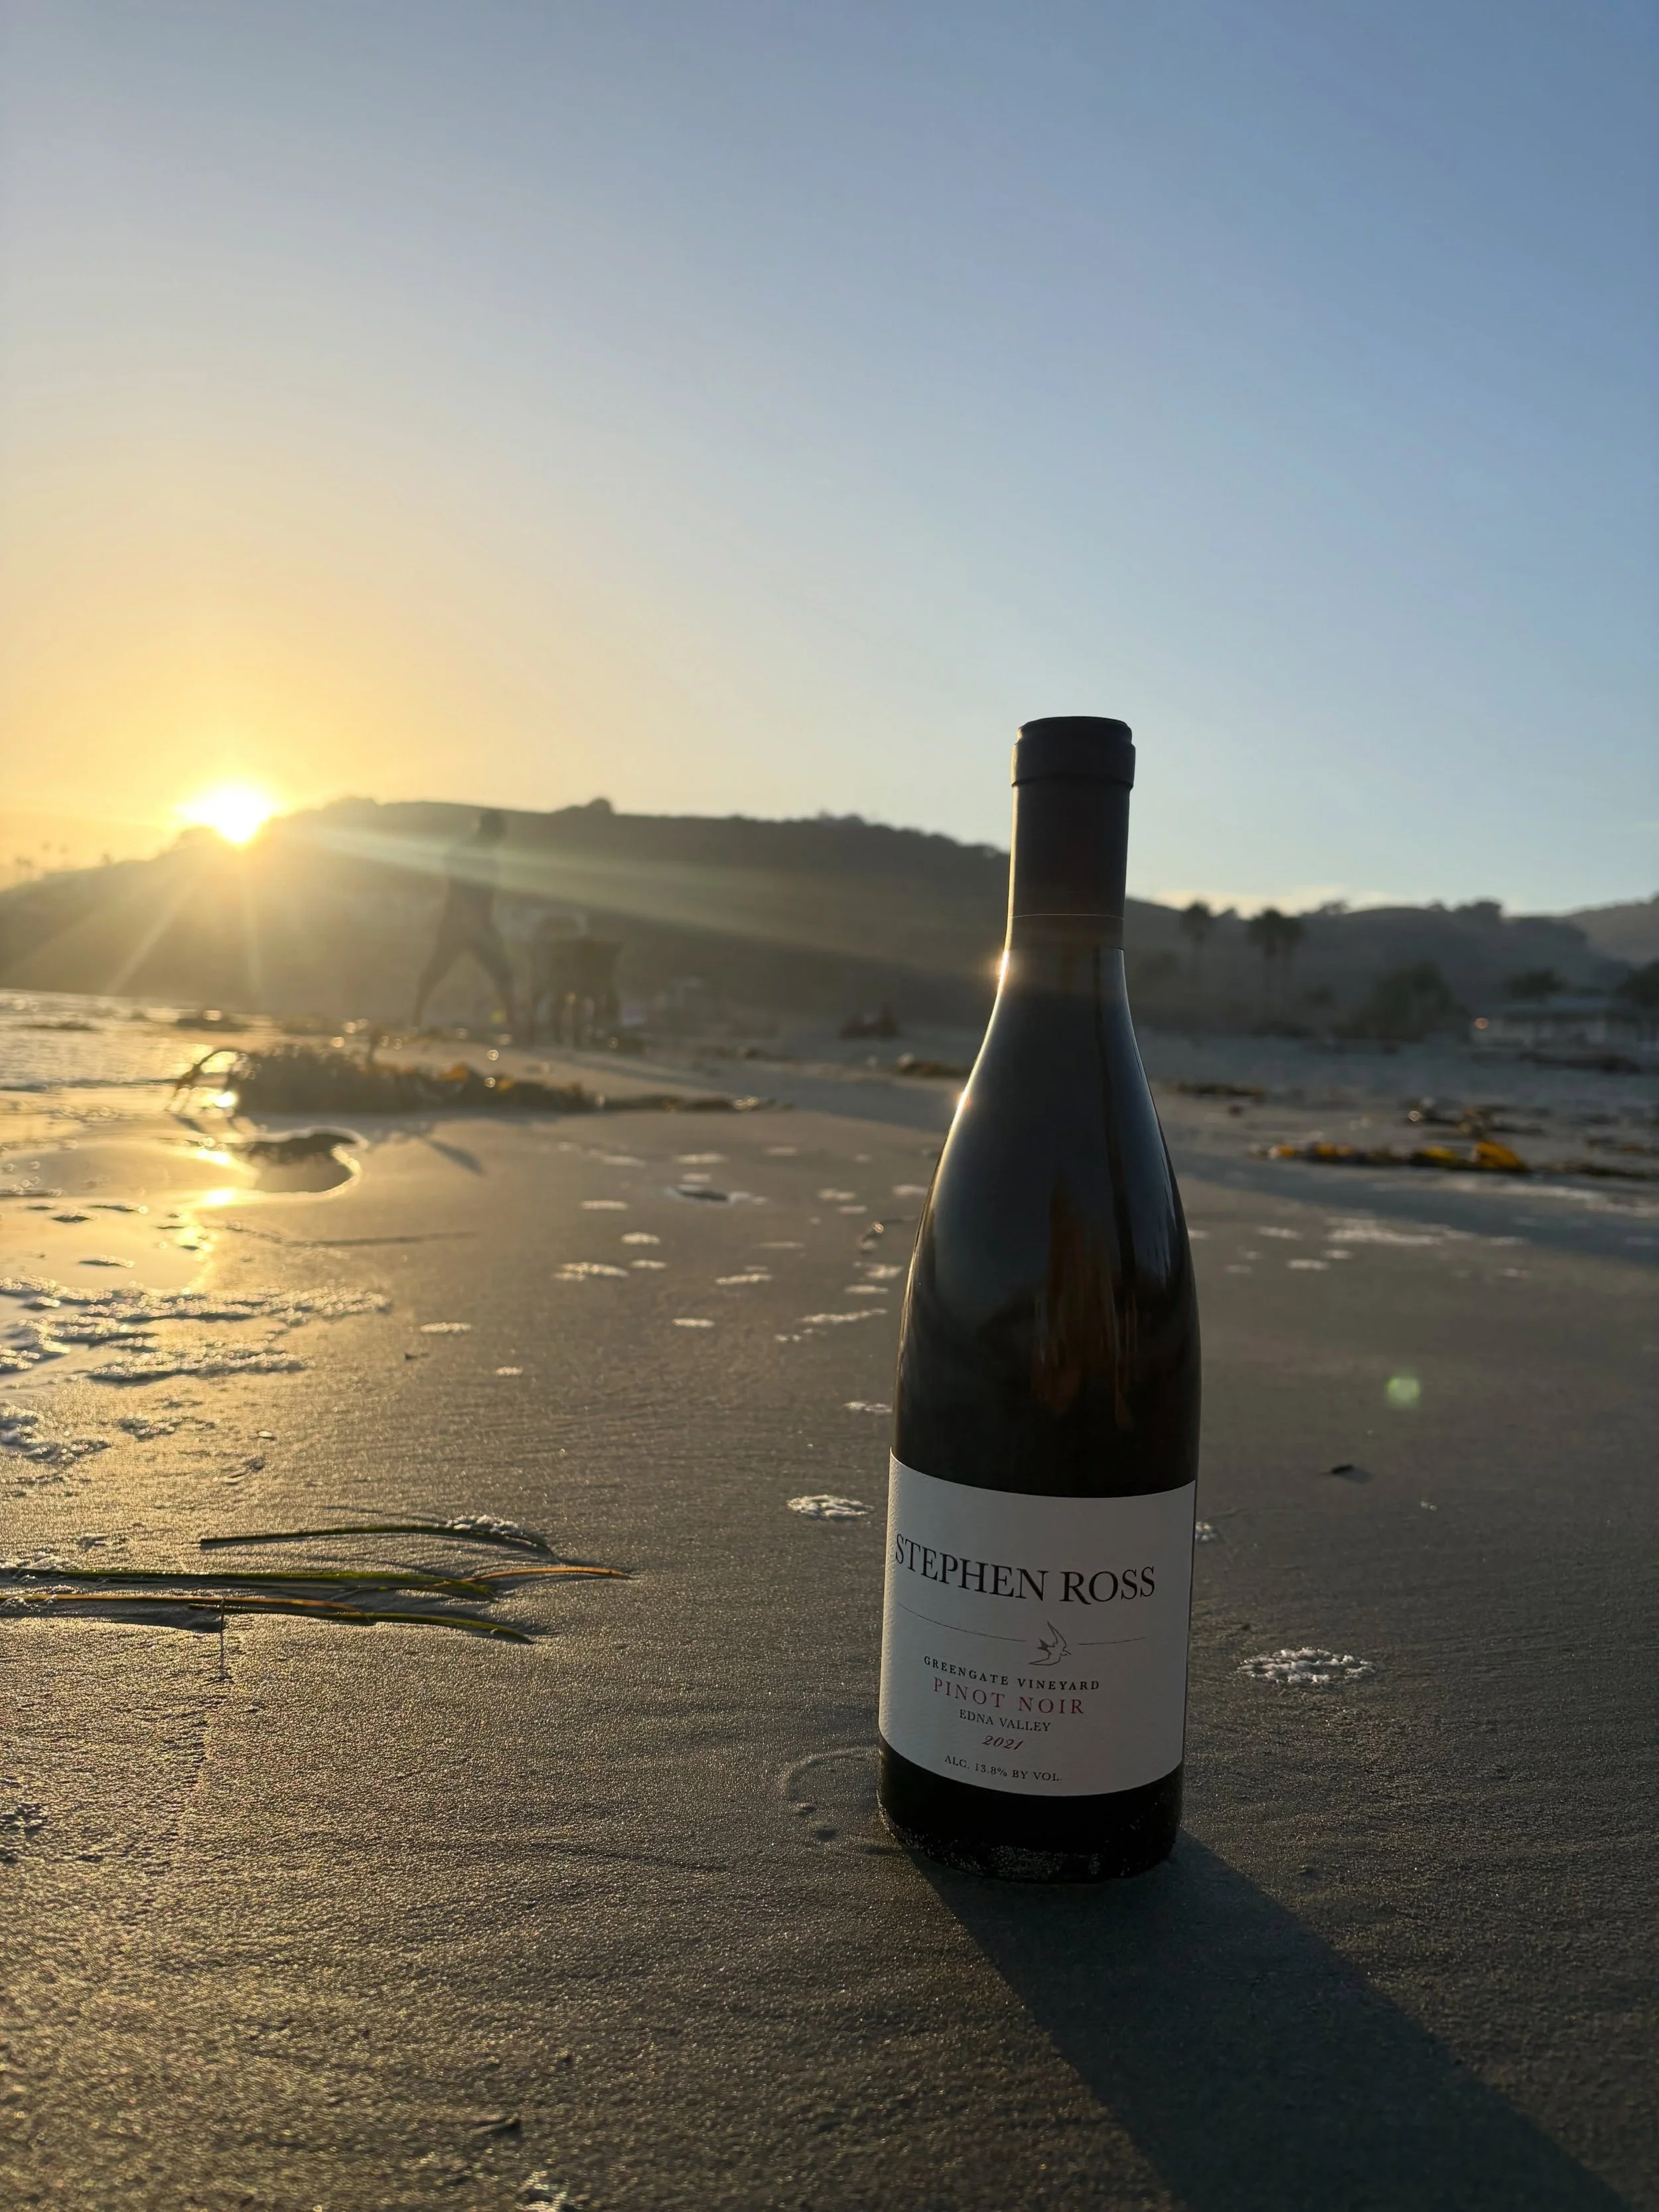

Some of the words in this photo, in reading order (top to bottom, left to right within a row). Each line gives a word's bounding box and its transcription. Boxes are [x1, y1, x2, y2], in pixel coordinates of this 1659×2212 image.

[895, 1533, 1049, 1601] STEPHEN
[1059, 1566, 1155, 1605] ROSS
[924, 1656, 1009, 1685] GREENGATE
[1017, 1678, 1100, 1690] VINEYARD
[933, 1677, 1005, 1708] PINOT
[1019, 1696, 1085, 1714] NOIR
[959, 1709, 994, 1726] EDNA
[999, 1718, 1051, 1732] VALLEY
[981, 1735, 1025, 1750] 2021
[945, 1755, 970, 1769] ALC.
[975, 1763, 1007, 1777] 13.8%
[1012, 1769, 1028, 1779] BY
[1033, 1772, 1062, 1782] VOL.
